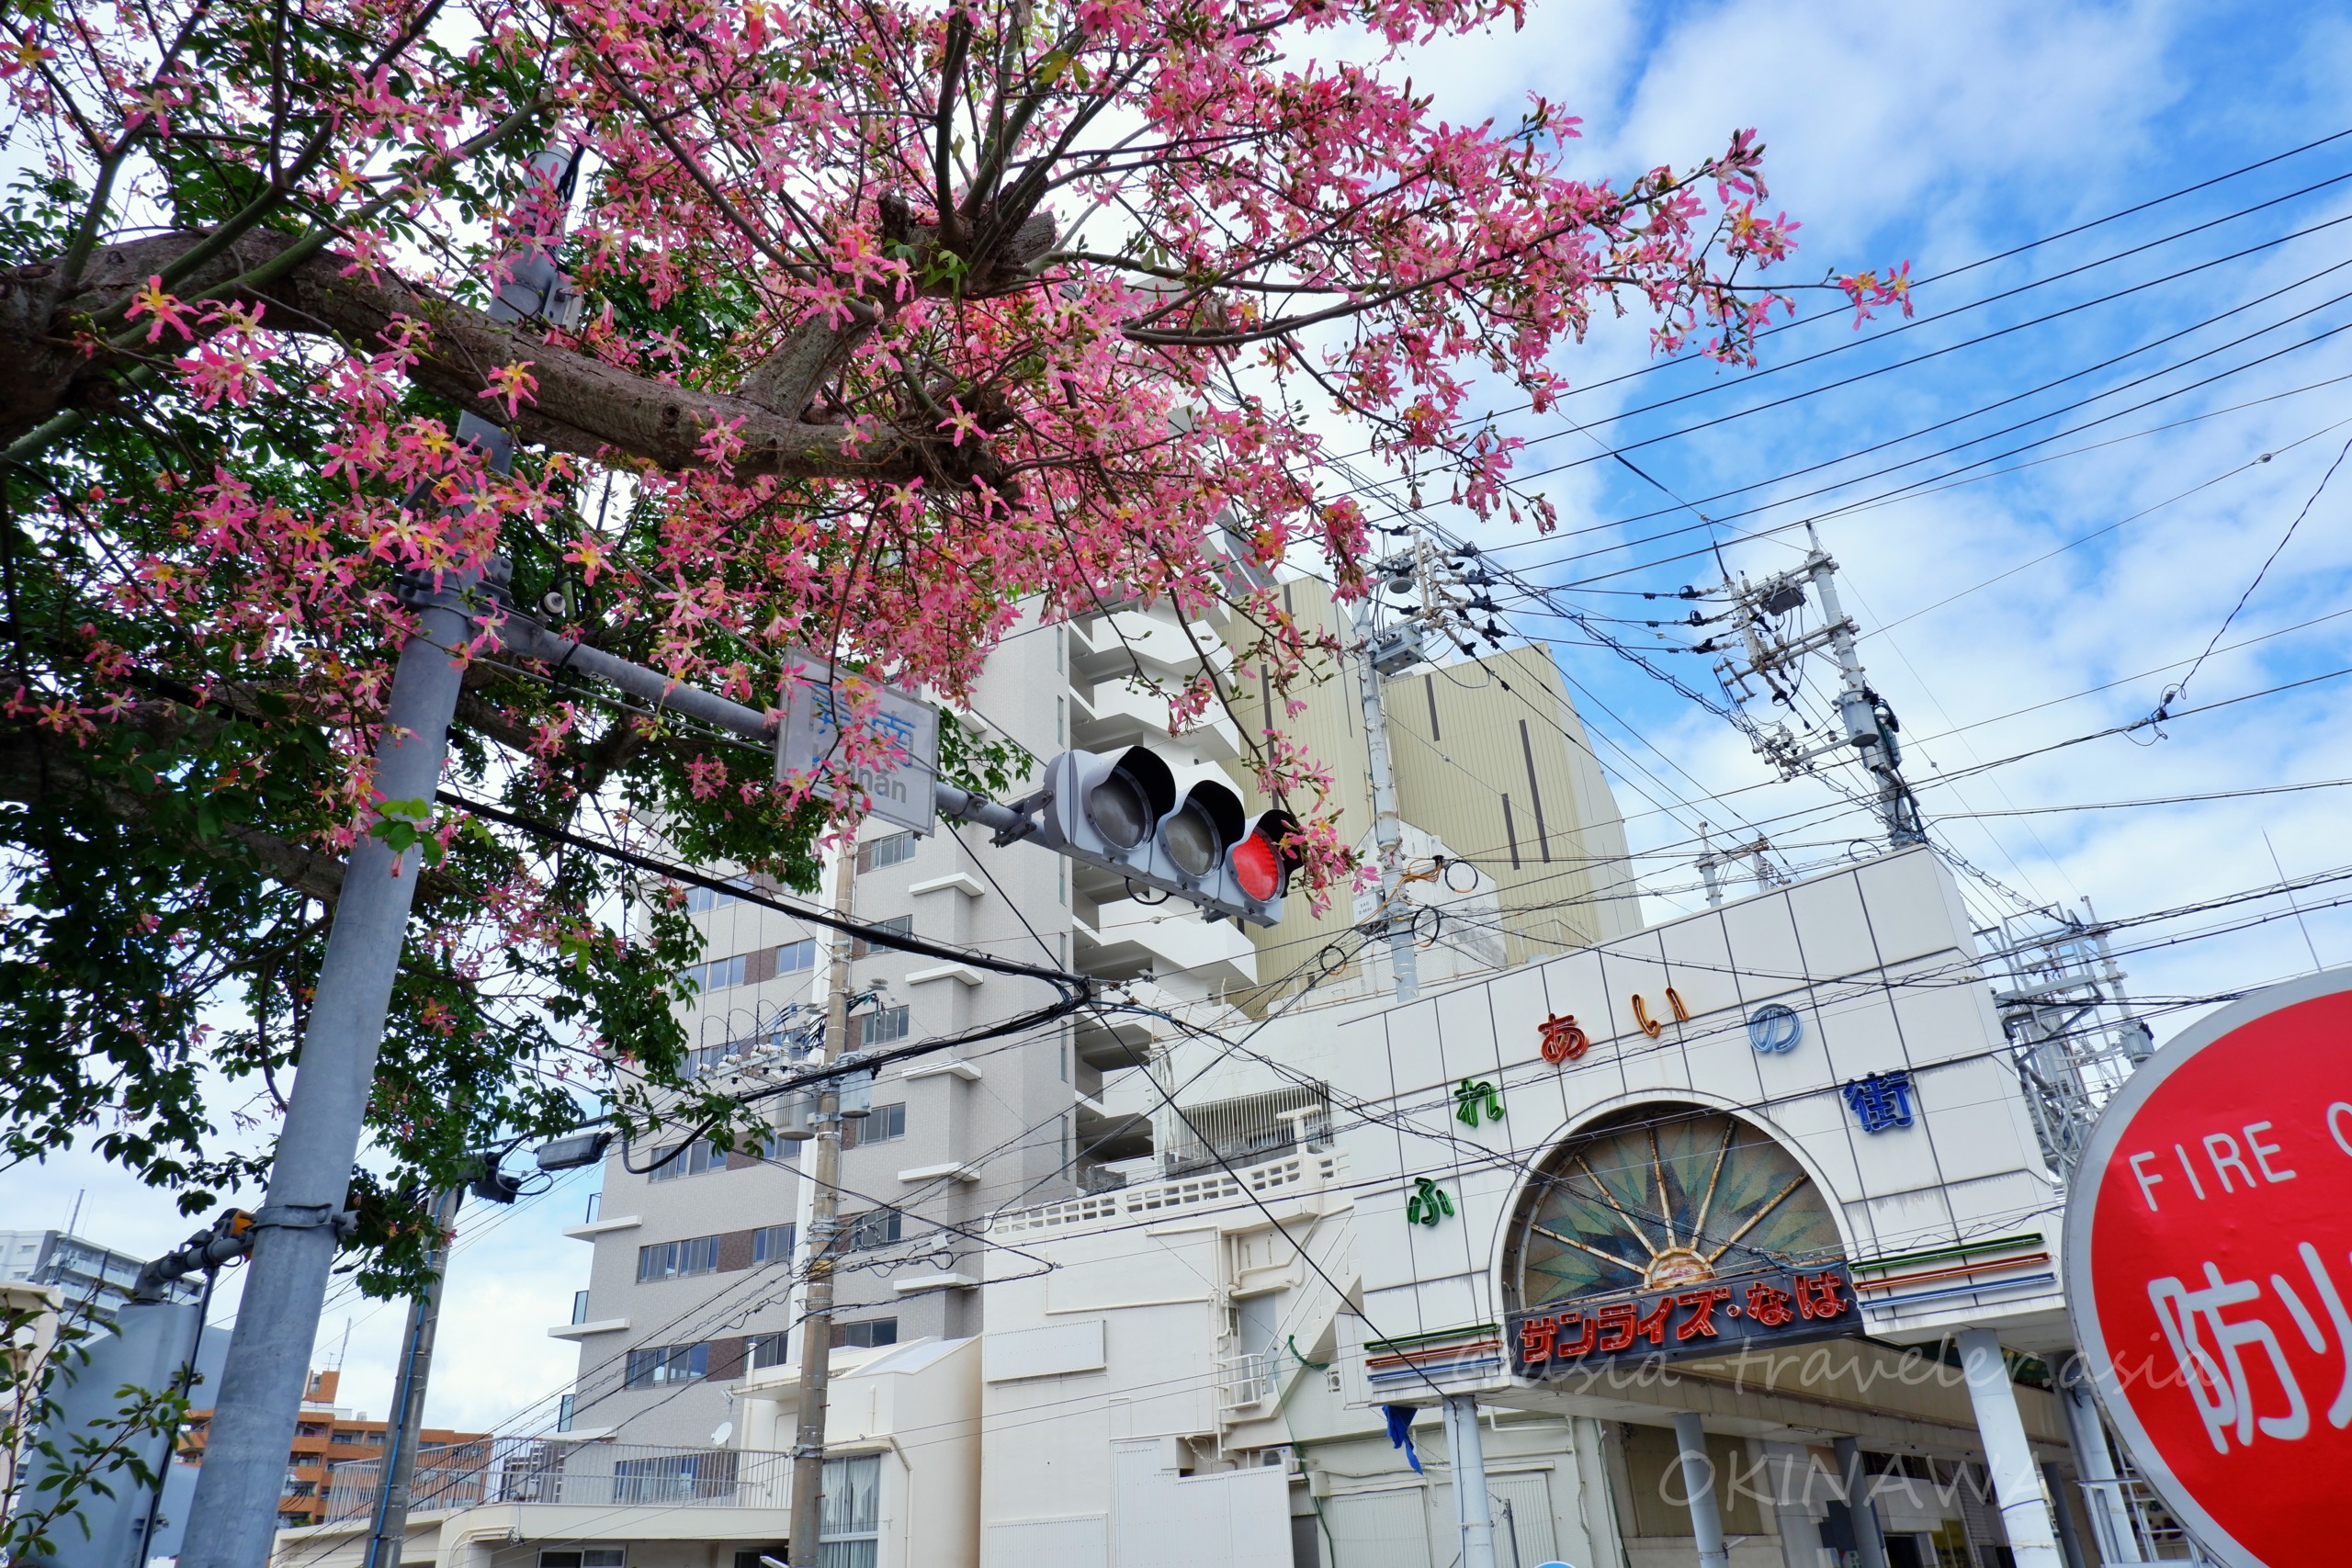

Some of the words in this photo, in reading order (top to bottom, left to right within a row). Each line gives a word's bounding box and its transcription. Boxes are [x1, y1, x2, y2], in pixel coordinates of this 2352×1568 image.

[1406, 987, 1916, 1227] ふれあいの街
[2129, 1120, 2297, 1213] FIRE
[1520, 1271, 1849, 1362] サンライズ・なは
